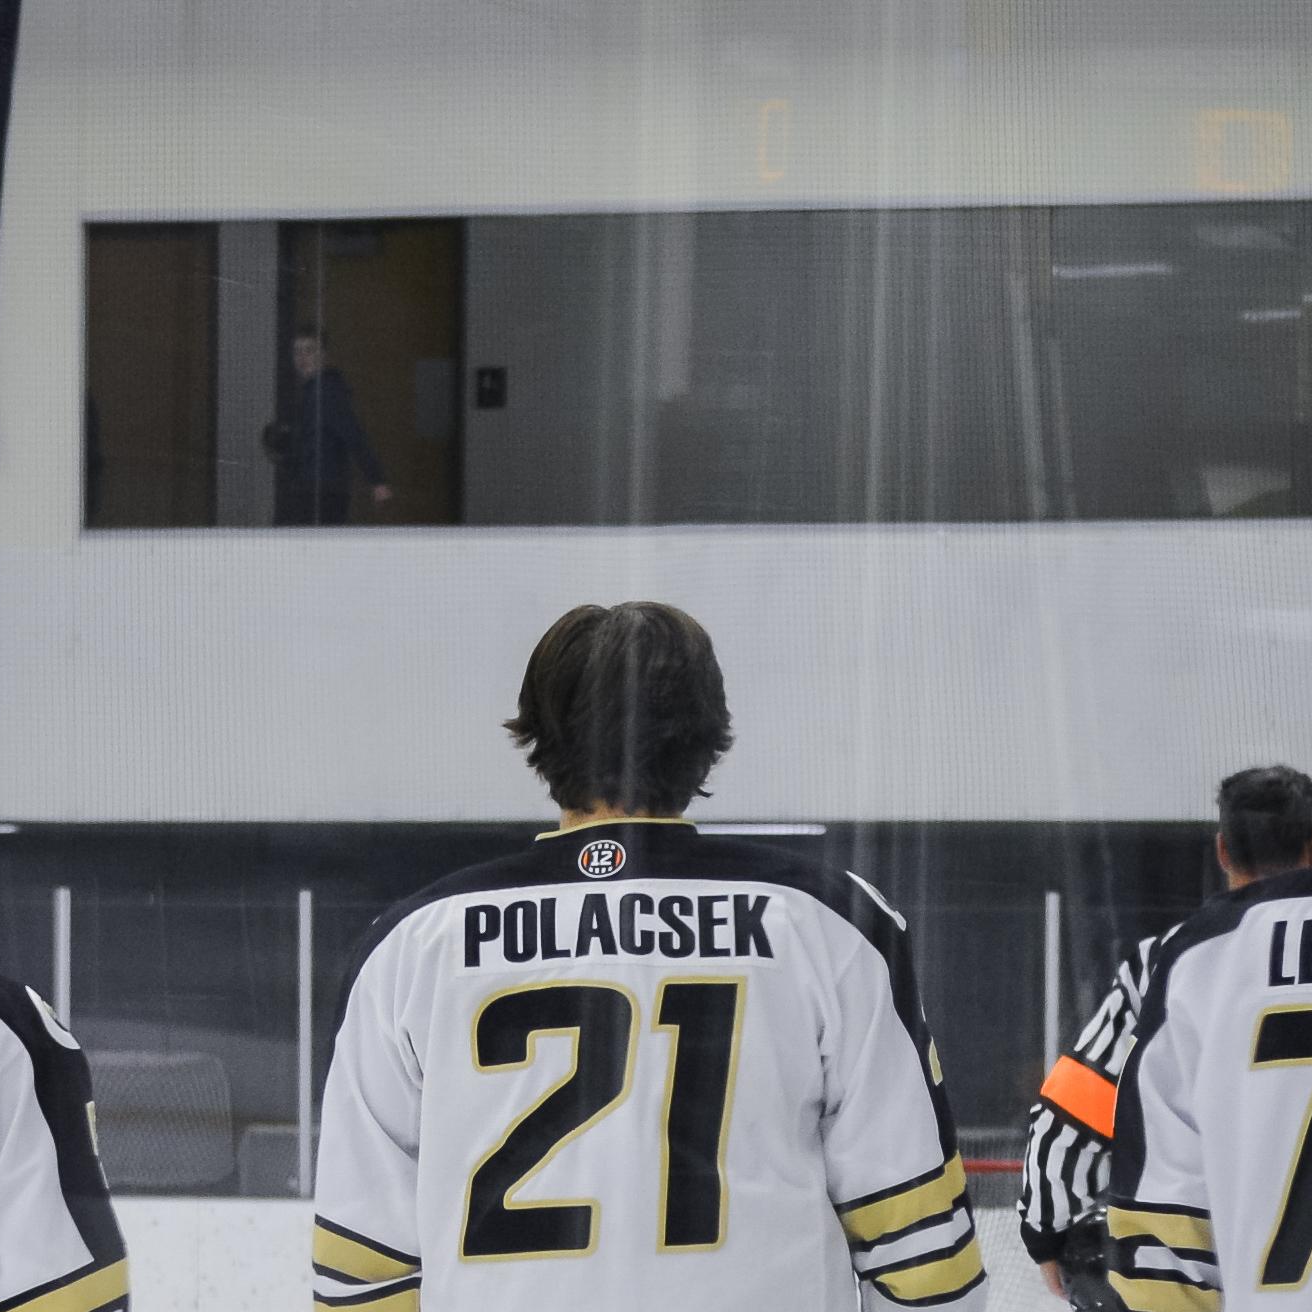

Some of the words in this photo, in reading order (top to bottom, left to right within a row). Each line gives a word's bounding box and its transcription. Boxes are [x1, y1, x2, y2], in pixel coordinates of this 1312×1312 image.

[591, 850, 613, 867] 12
[464, 892, 775, 968] POLACSEK
[458, 975, 748, 1263] 21
